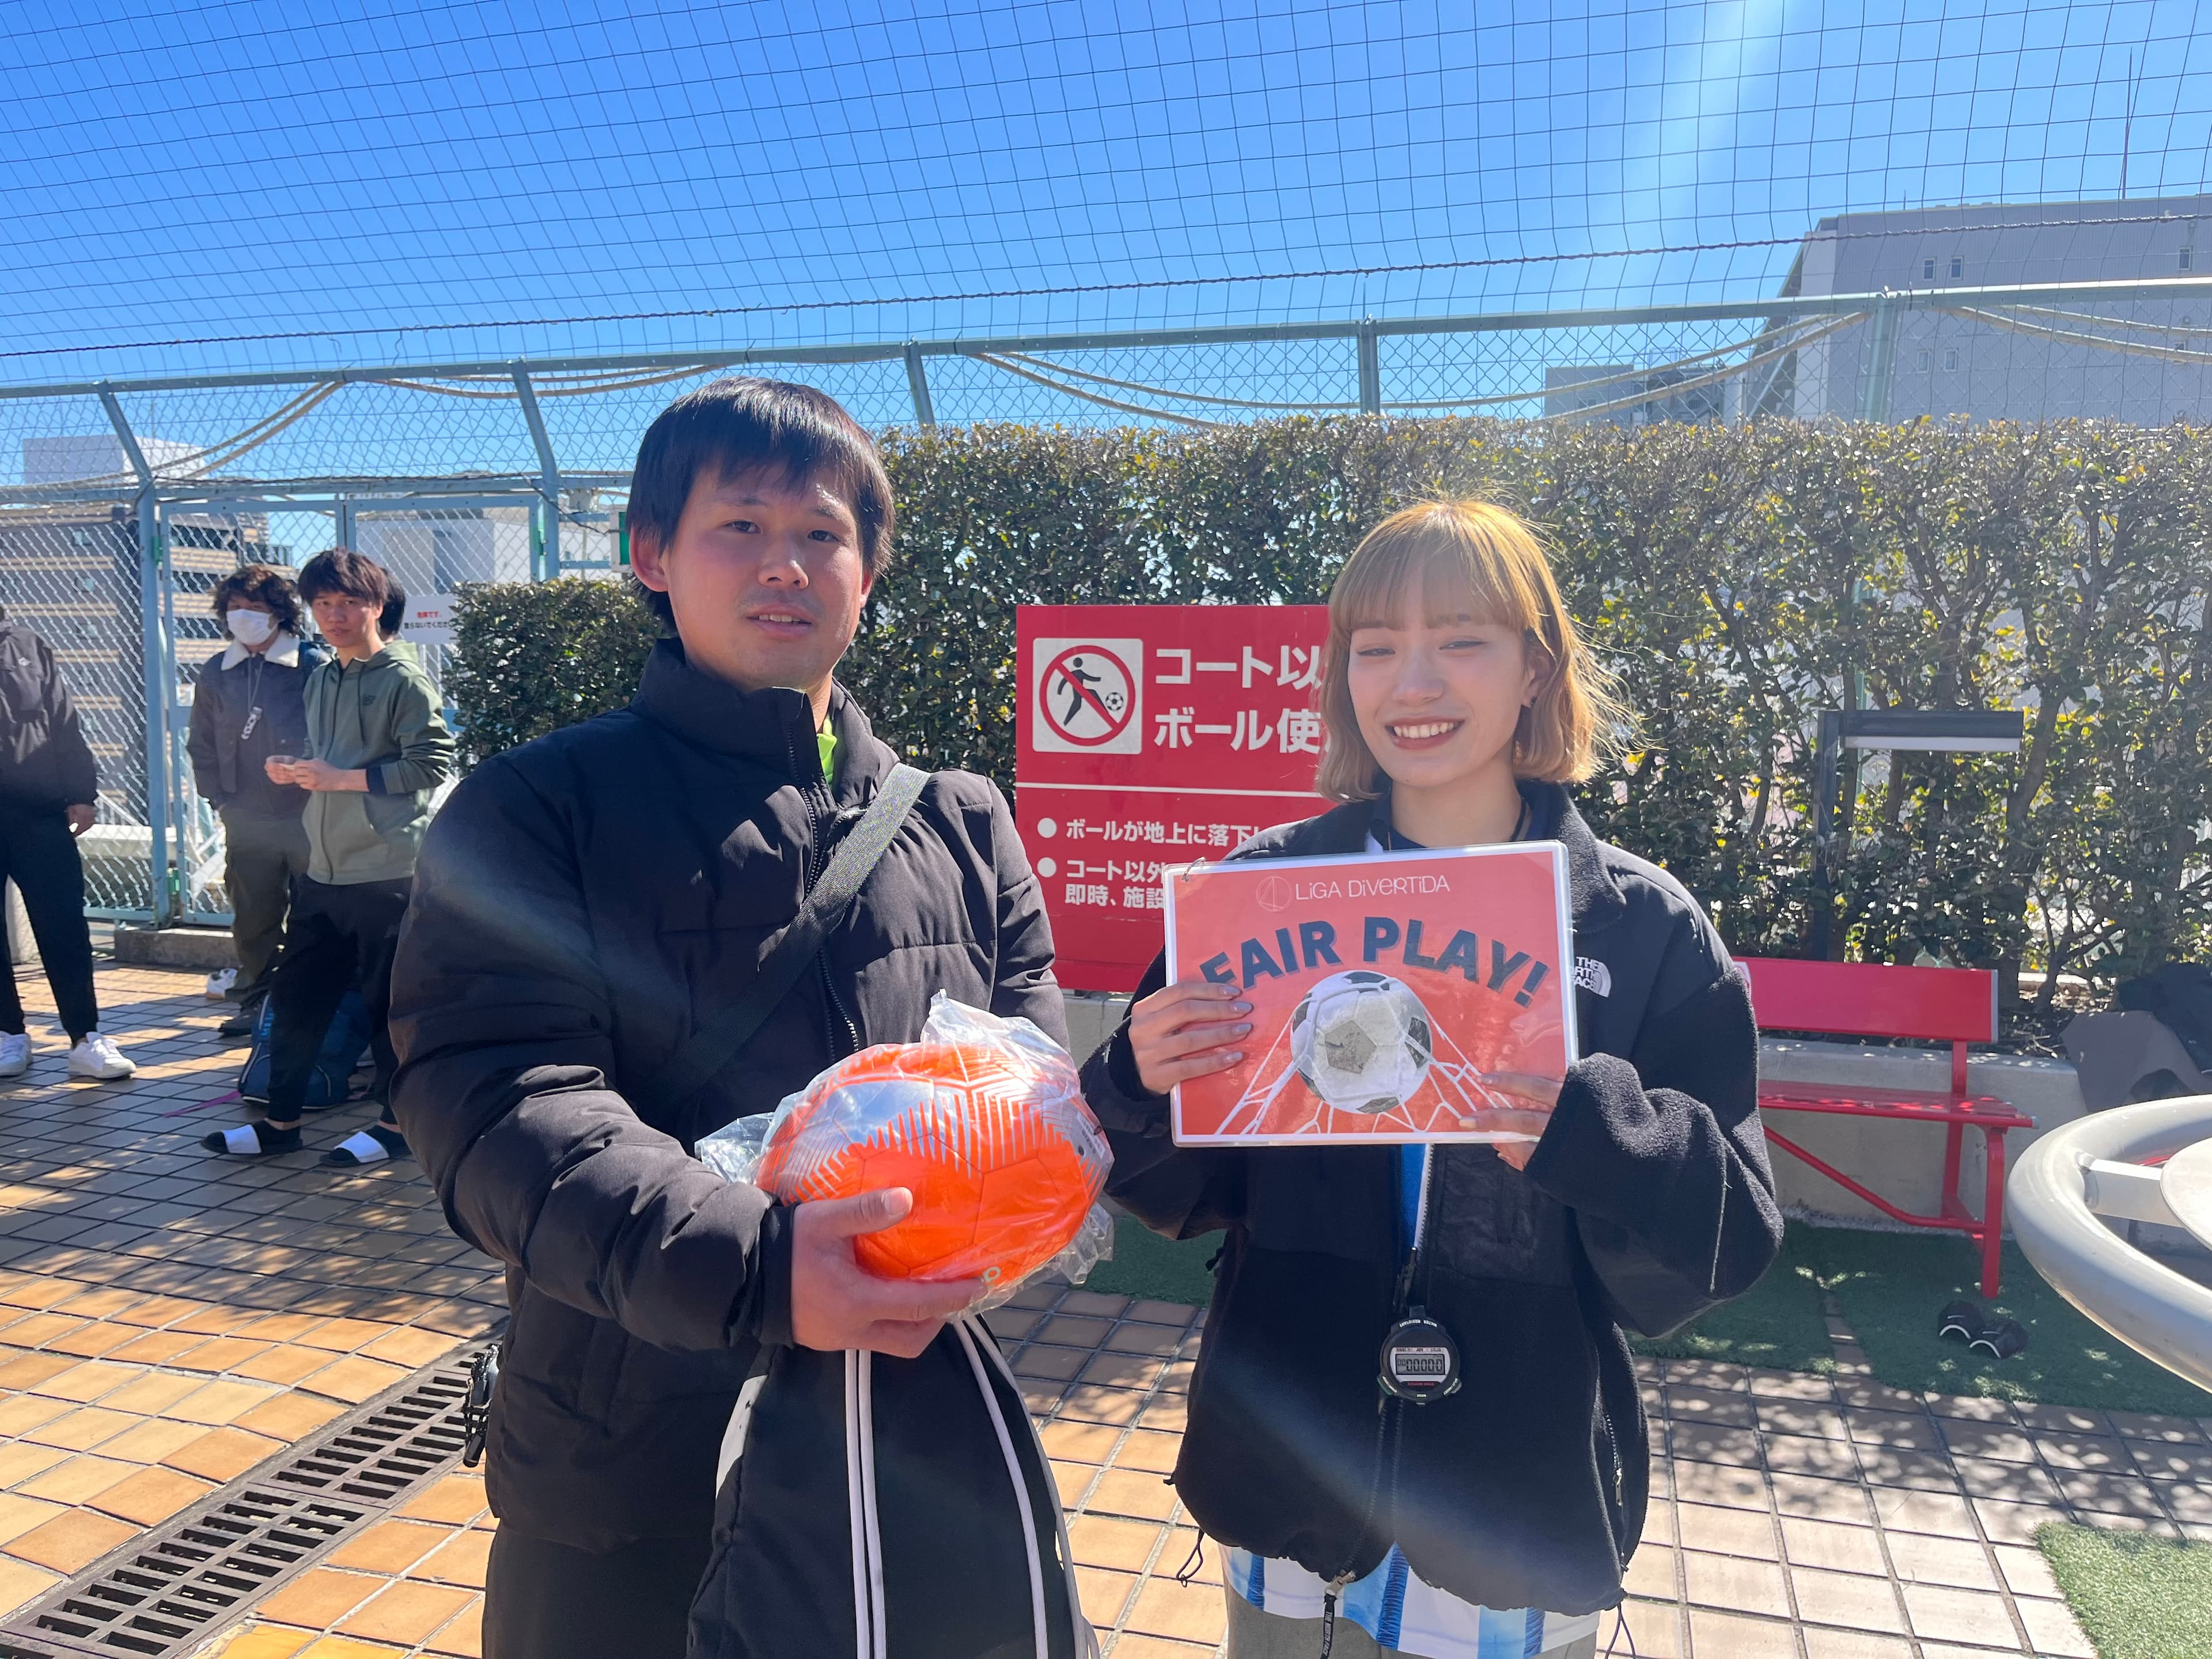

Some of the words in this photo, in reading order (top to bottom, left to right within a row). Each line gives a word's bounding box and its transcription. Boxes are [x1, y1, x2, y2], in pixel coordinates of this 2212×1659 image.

[1156, 645, 1323, 690] コート以
[1154, 706, 1330, 754] ボール使
[1199, 921, 1343, 991] FAIR
[1363, 916, 1551, 1009] PLAY!
[1574, 966, 1595, 979] RTH
[1576, 956, 1600, 969] THE
[1573, 976, 1594, 989] ACE
